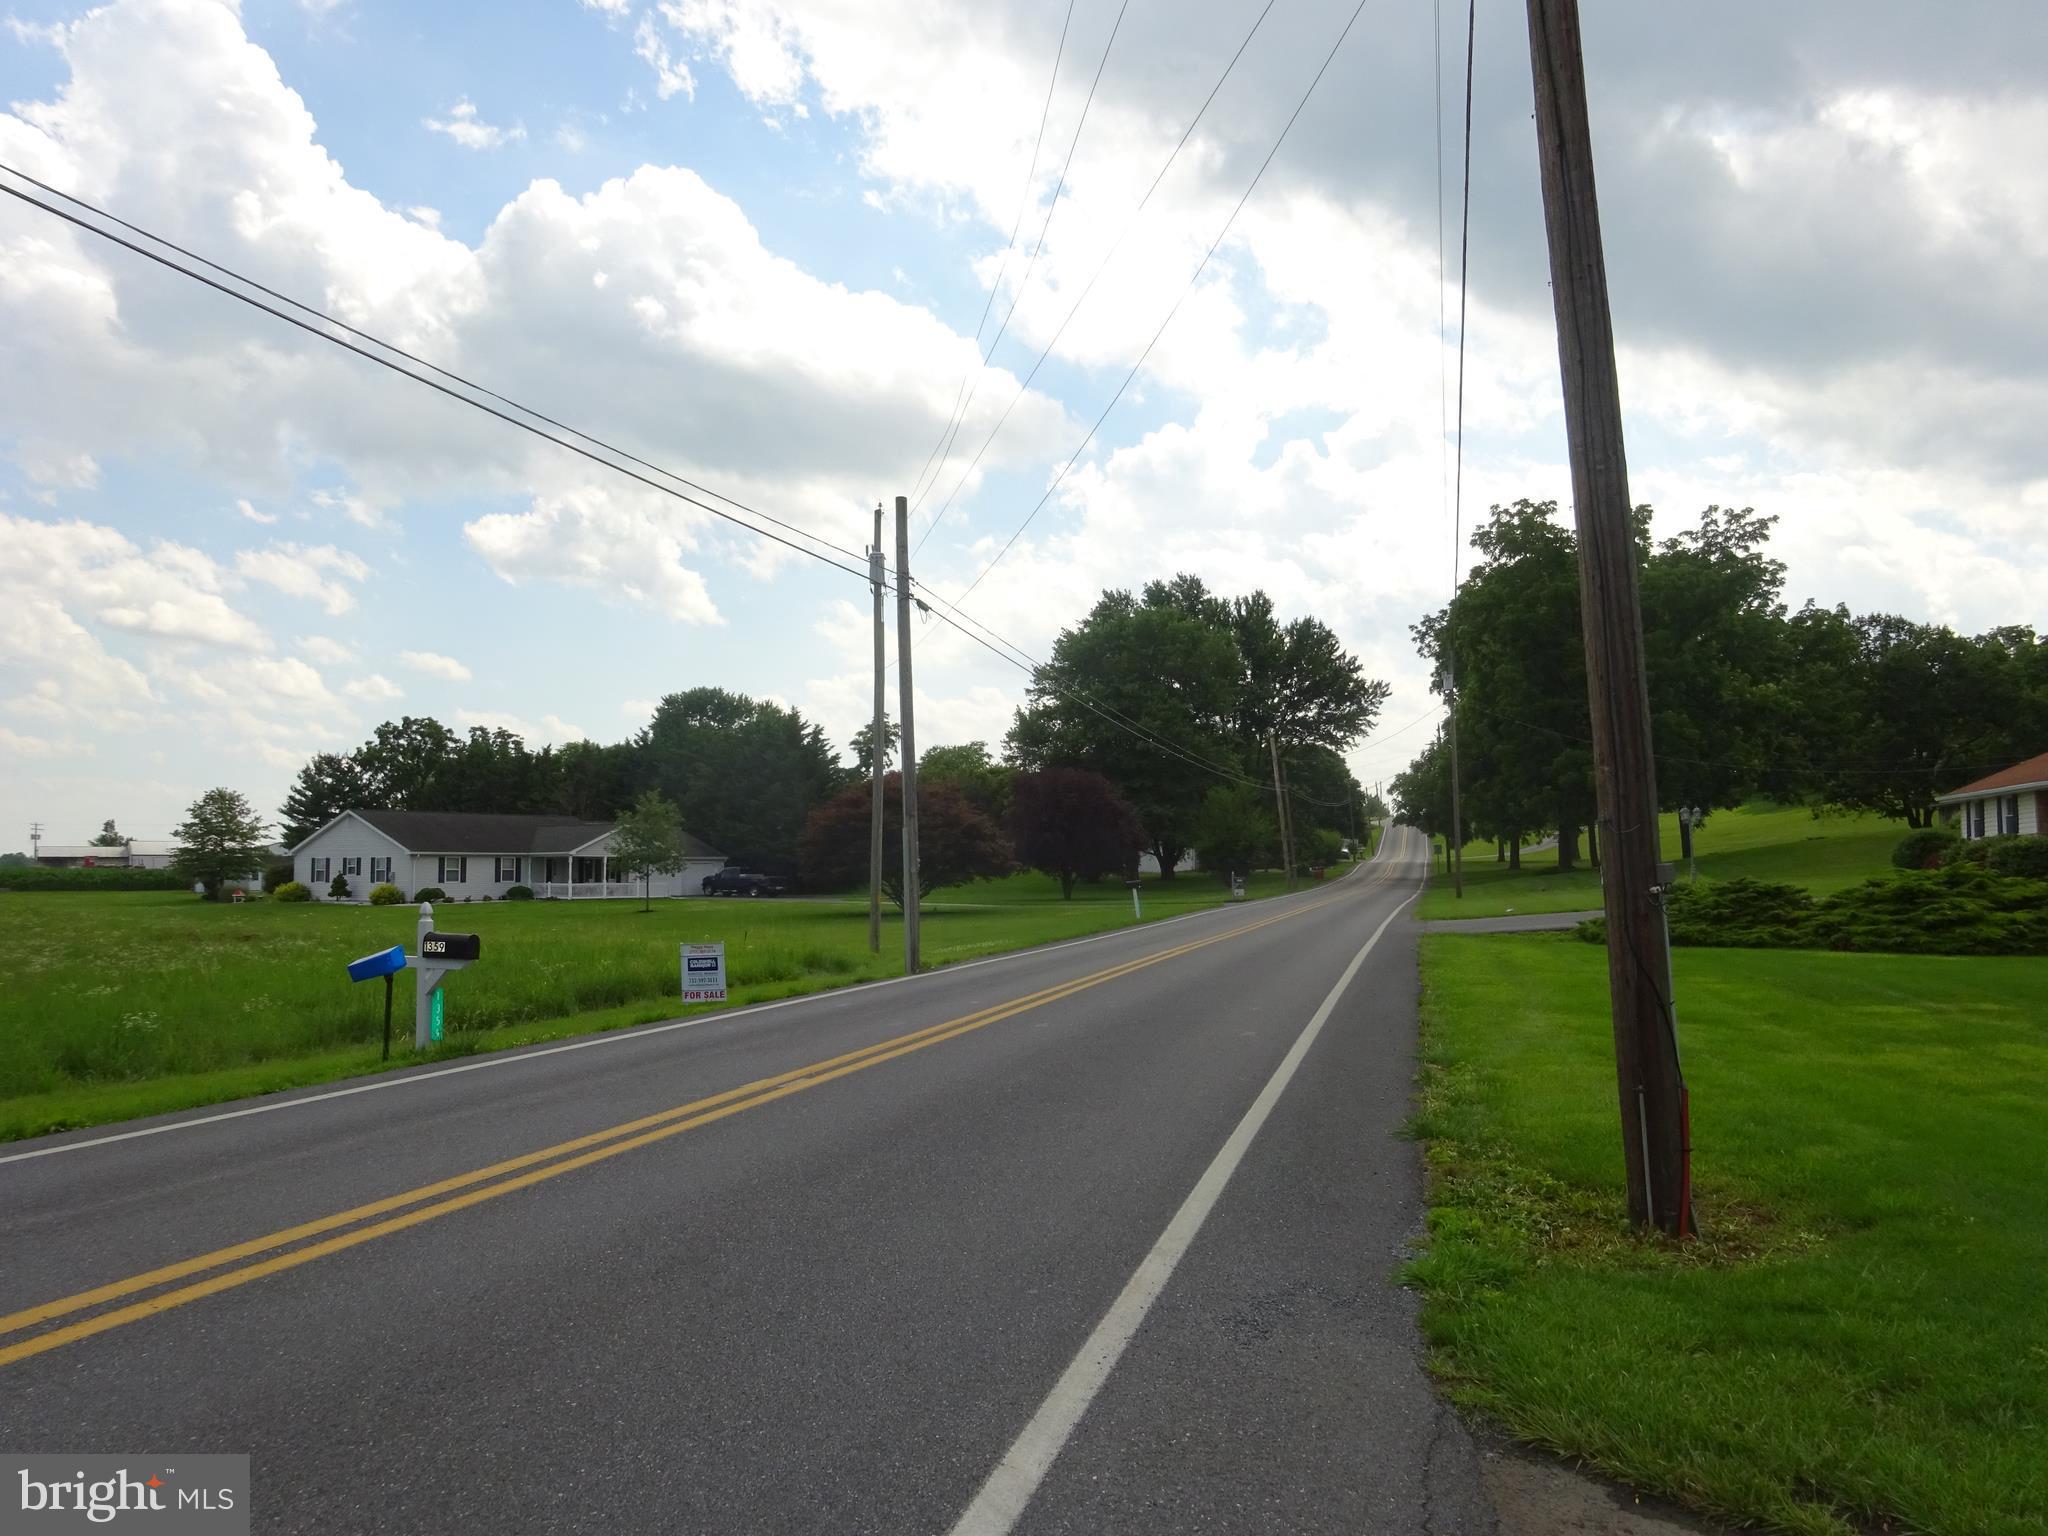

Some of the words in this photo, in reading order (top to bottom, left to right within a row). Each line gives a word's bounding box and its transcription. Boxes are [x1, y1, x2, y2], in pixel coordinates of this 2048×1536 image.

[424, 942, 445, 952] 1359
[684, 991, 701, 999] FOR
[704, 991, 725, 999] SALE
